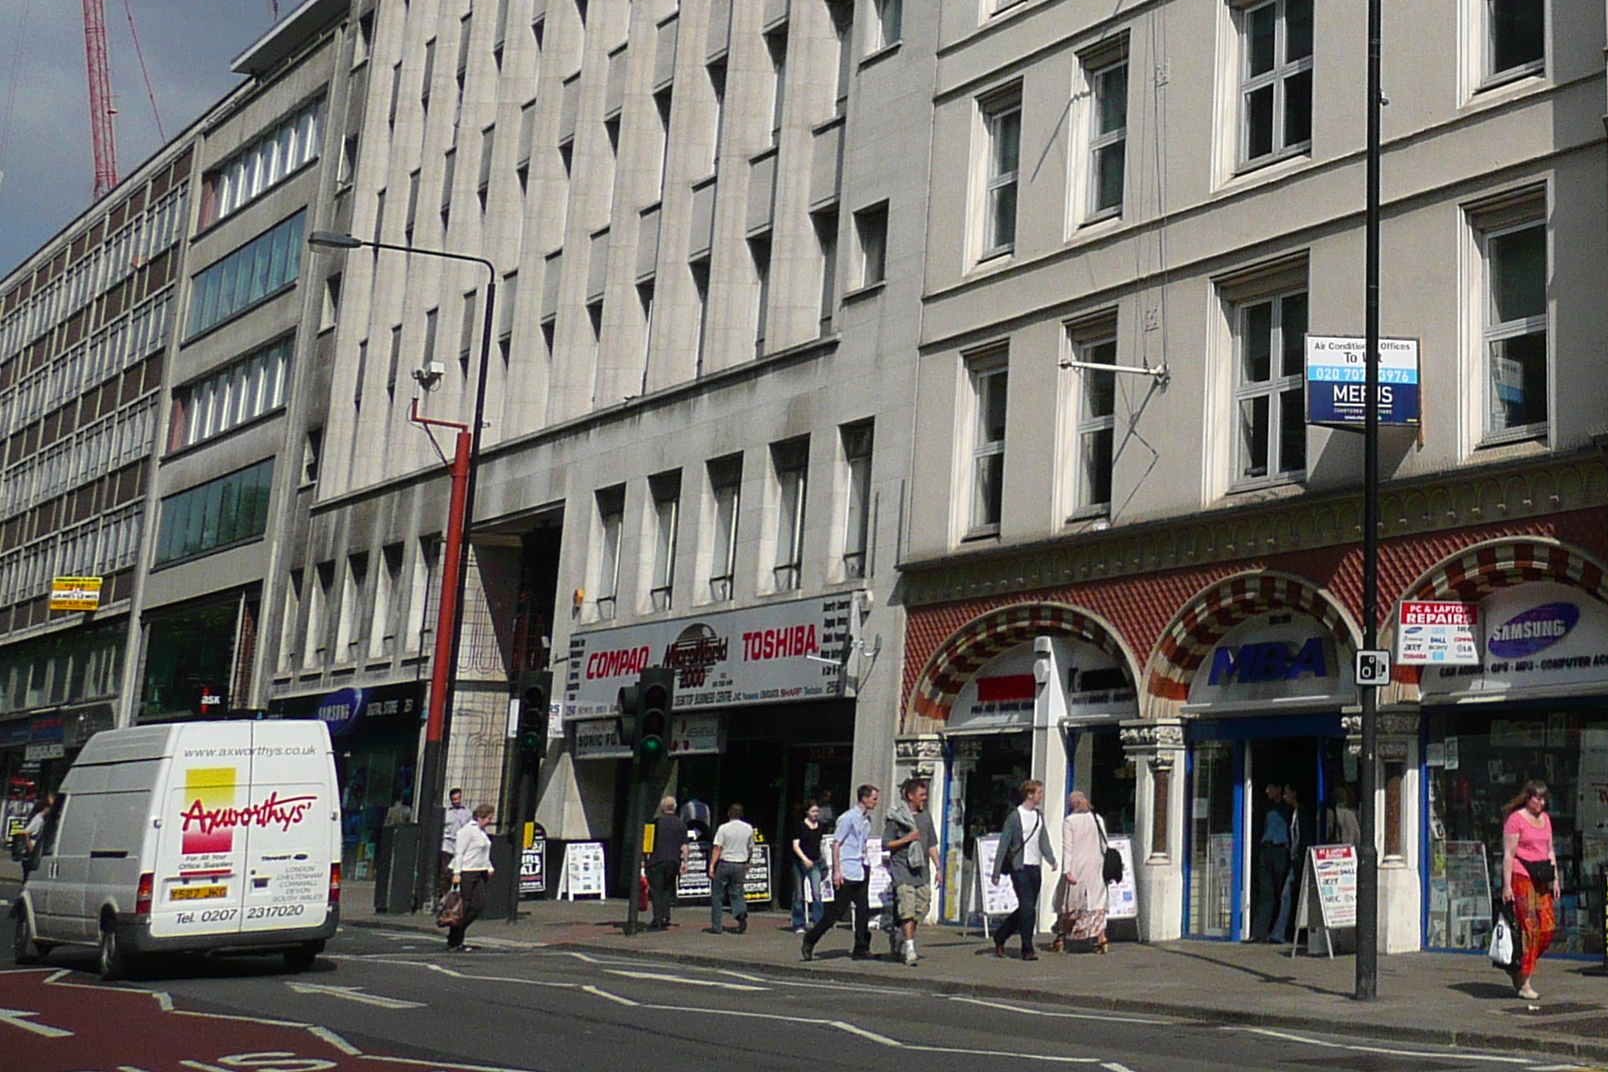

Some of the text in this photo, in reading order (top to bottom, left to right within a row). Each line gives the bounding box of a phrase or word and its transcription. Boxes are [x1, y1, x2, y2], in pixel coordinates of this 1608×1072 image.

[1315, 342, 1411, 351] Air Conditio Offices
[1343, 352, 1383, 364] To Lt
[1316, 368, 1340, 380] 020
[1378, 370, 1409, 382] 3976
[1410, 605, 1469, 613] PC & LAPTOP
[1406, 613, 1472, 624] REPAIRS
[1493, 619, 1566, 642] SAMSUNG
[743, 624, 817, 662] TOSHIBA
[586, 646, 650, 680] COMPAQ
[1207, 637, 1327, 686] MBA
[1541, 656, 1591, 670] COMPUTER
[679, 668, 706, 689] 2000
[184, 746, 317, 758] www.axworthys.co.uk
[203, 861, 234, 869] Supplies
[276, 872, 324, 881] CHELTENHAM
[279, 879, 318, 888] CORNWALL
[176, 904, 304, 924] Tel. 0207 2317020
